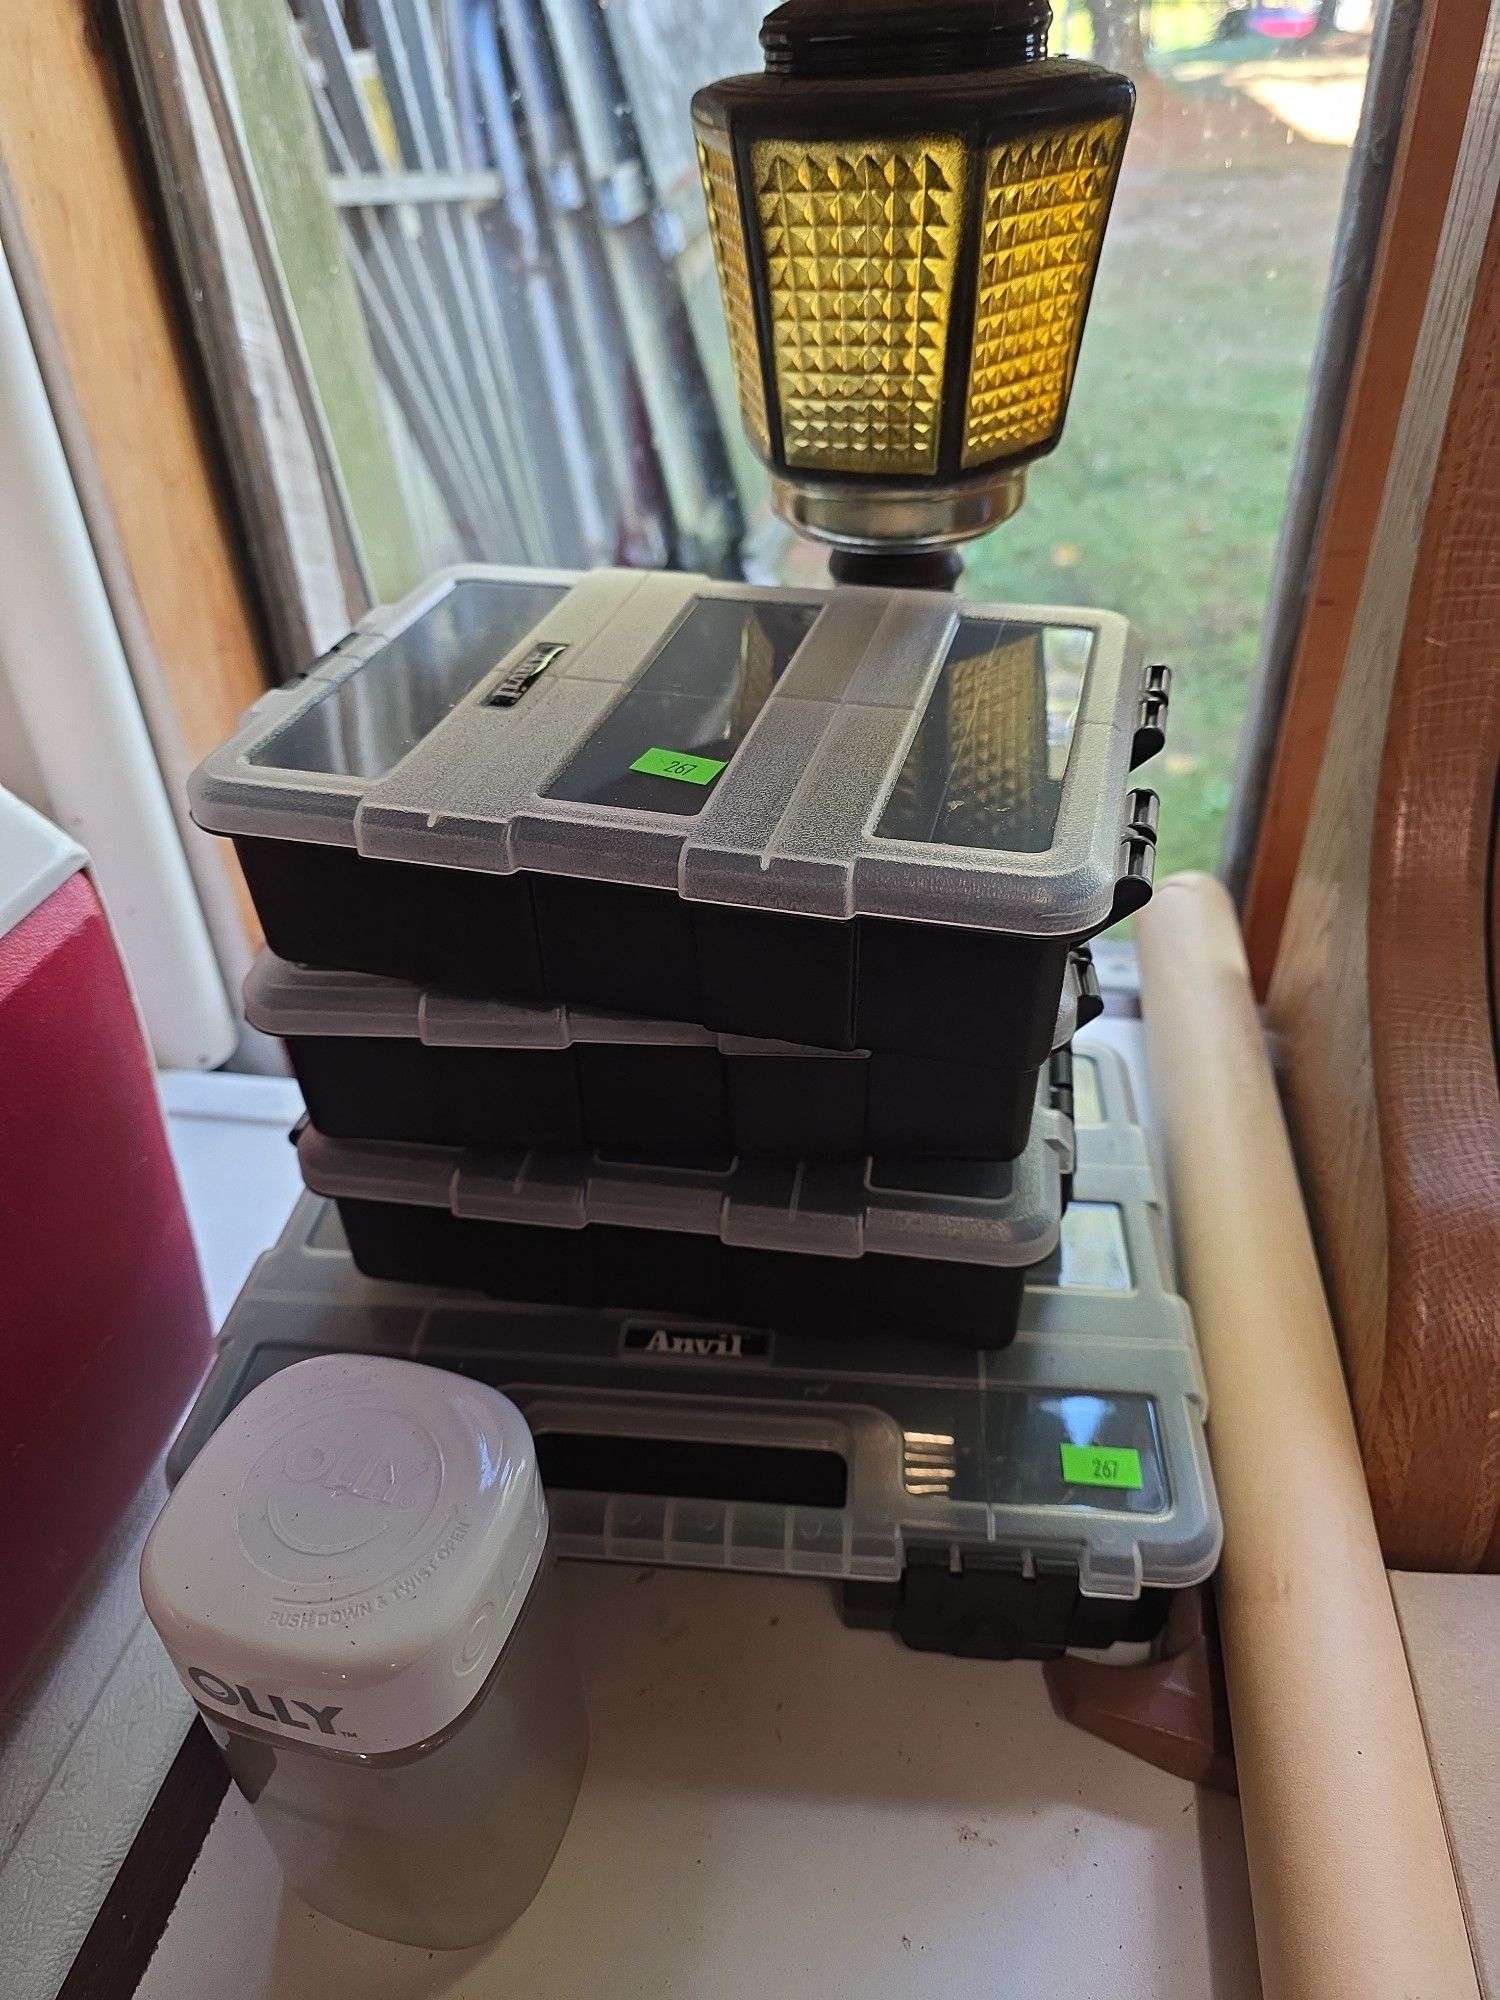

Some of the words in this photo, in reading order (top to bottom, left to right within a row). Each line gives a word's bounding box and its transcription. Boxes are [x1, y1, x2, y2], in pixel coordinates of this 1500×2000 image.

[663, 760, 697, 777] 267
[644, 1329, 743, 1358] Anvil
[1091, 1458, 1118, 1478] 267
[269, 1610, 314, 1630] PUSH
[316, 1601, 373, 1628] DOWN
[390, 1557, 440, 1601] TWIST
[435, 1519, 472, 1561] OPEN
[188, 1666, 343, 1735] OLLY
